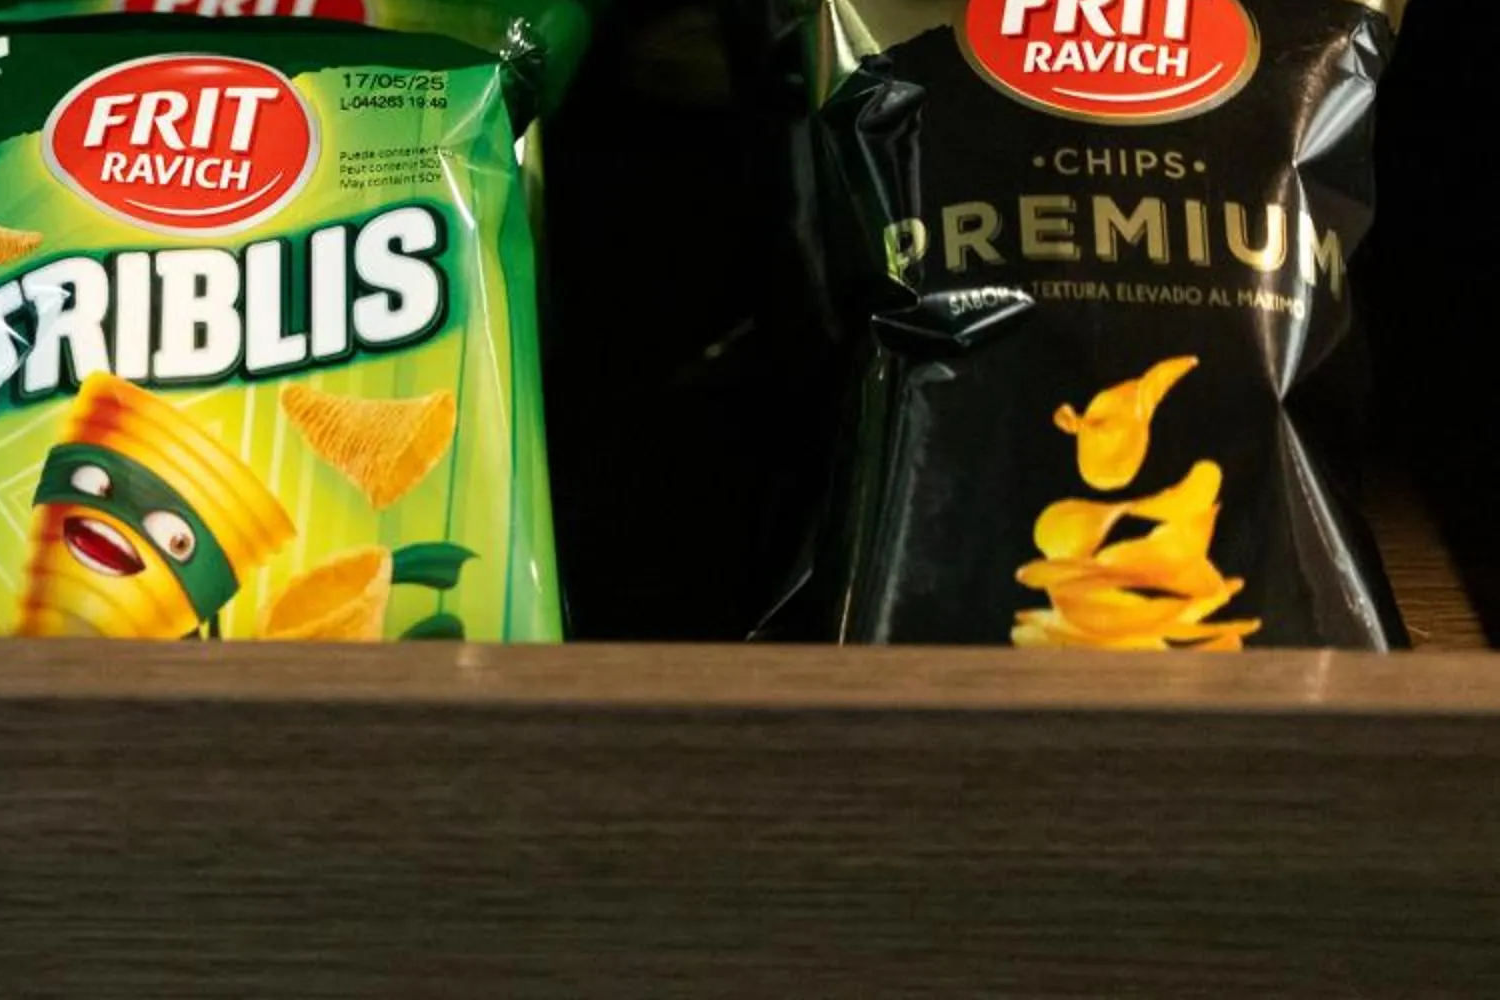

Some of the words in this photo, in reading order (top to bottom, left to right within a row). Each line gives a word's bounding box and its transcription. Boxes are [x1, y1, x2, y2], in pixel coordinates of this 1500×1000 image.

[1023, 40, 1190, 77] RAVICH
[342, 72, 445, 91] 17/05/25
[83, 87, 280, 151] FRIT
[100, 151, 251, 191] RAVICH
[884, 193, 1344, 299] PREMIUM
[1116, 282, 1201, 306] ELEVADO
[1208, 285, 1231, 308] AL
